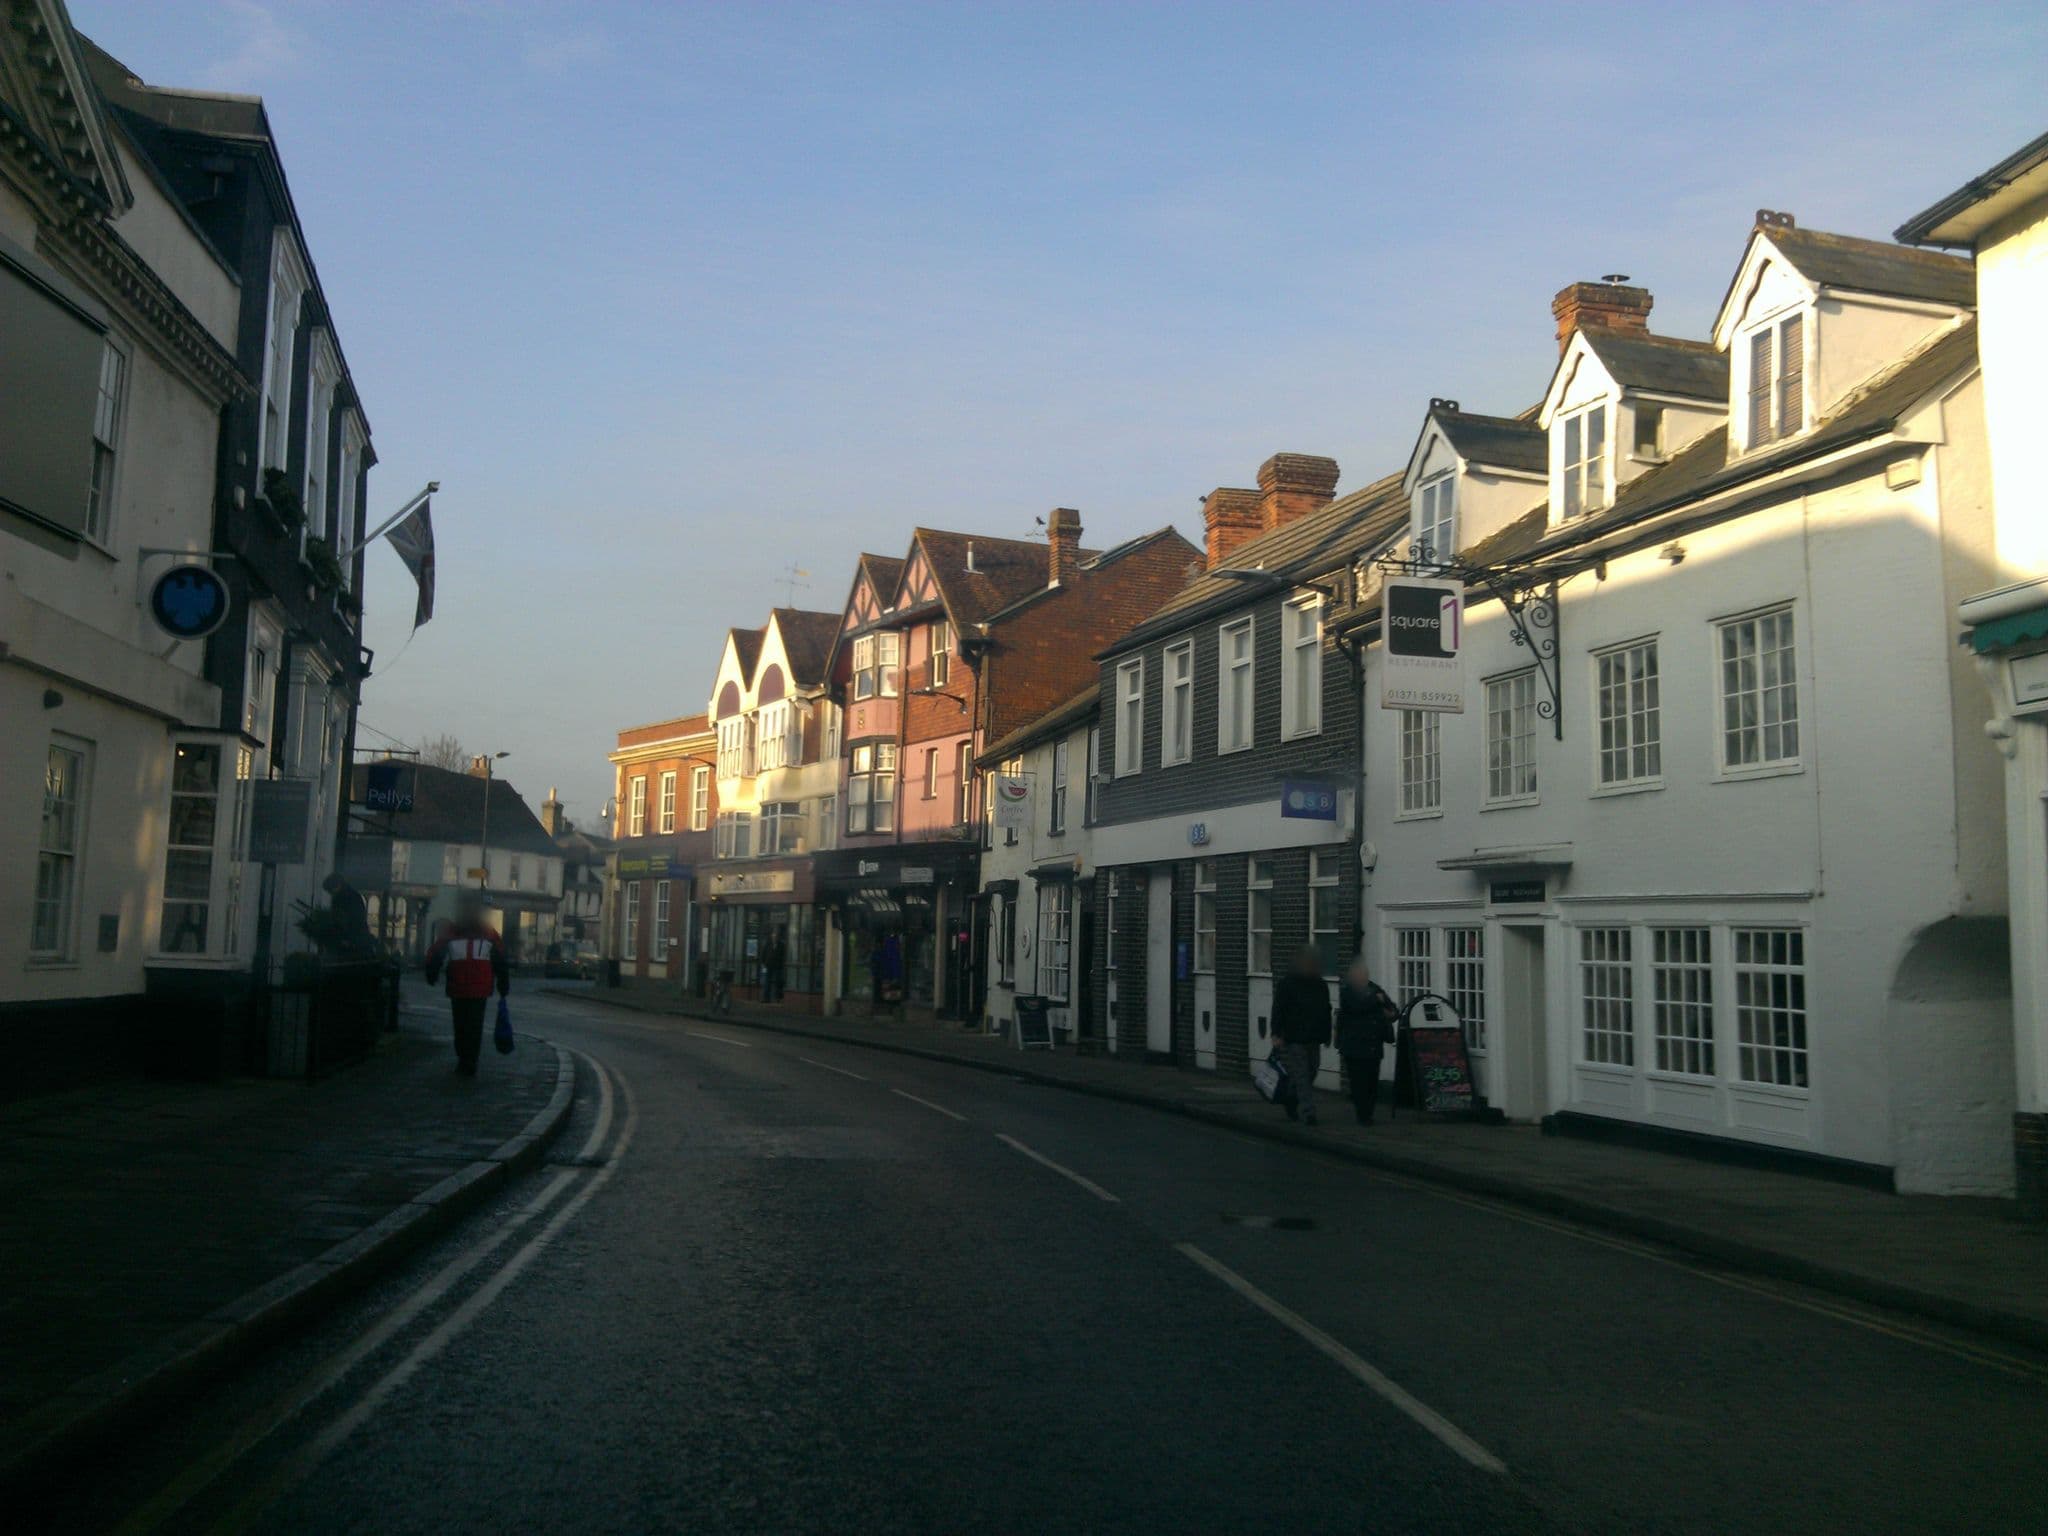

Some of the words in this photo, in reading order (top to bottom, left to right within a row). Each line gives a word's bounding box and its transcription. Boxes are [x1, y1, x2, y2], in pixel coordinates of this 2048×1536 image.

[1390, 614, 1440, 630] square
[1442, 598, 1459, 651] 1
[1388, 657, 1458, 670] RESTAURANT
[1388, 689, 1417, 699] 01371
[368, 788, 413, 809] Pellys
